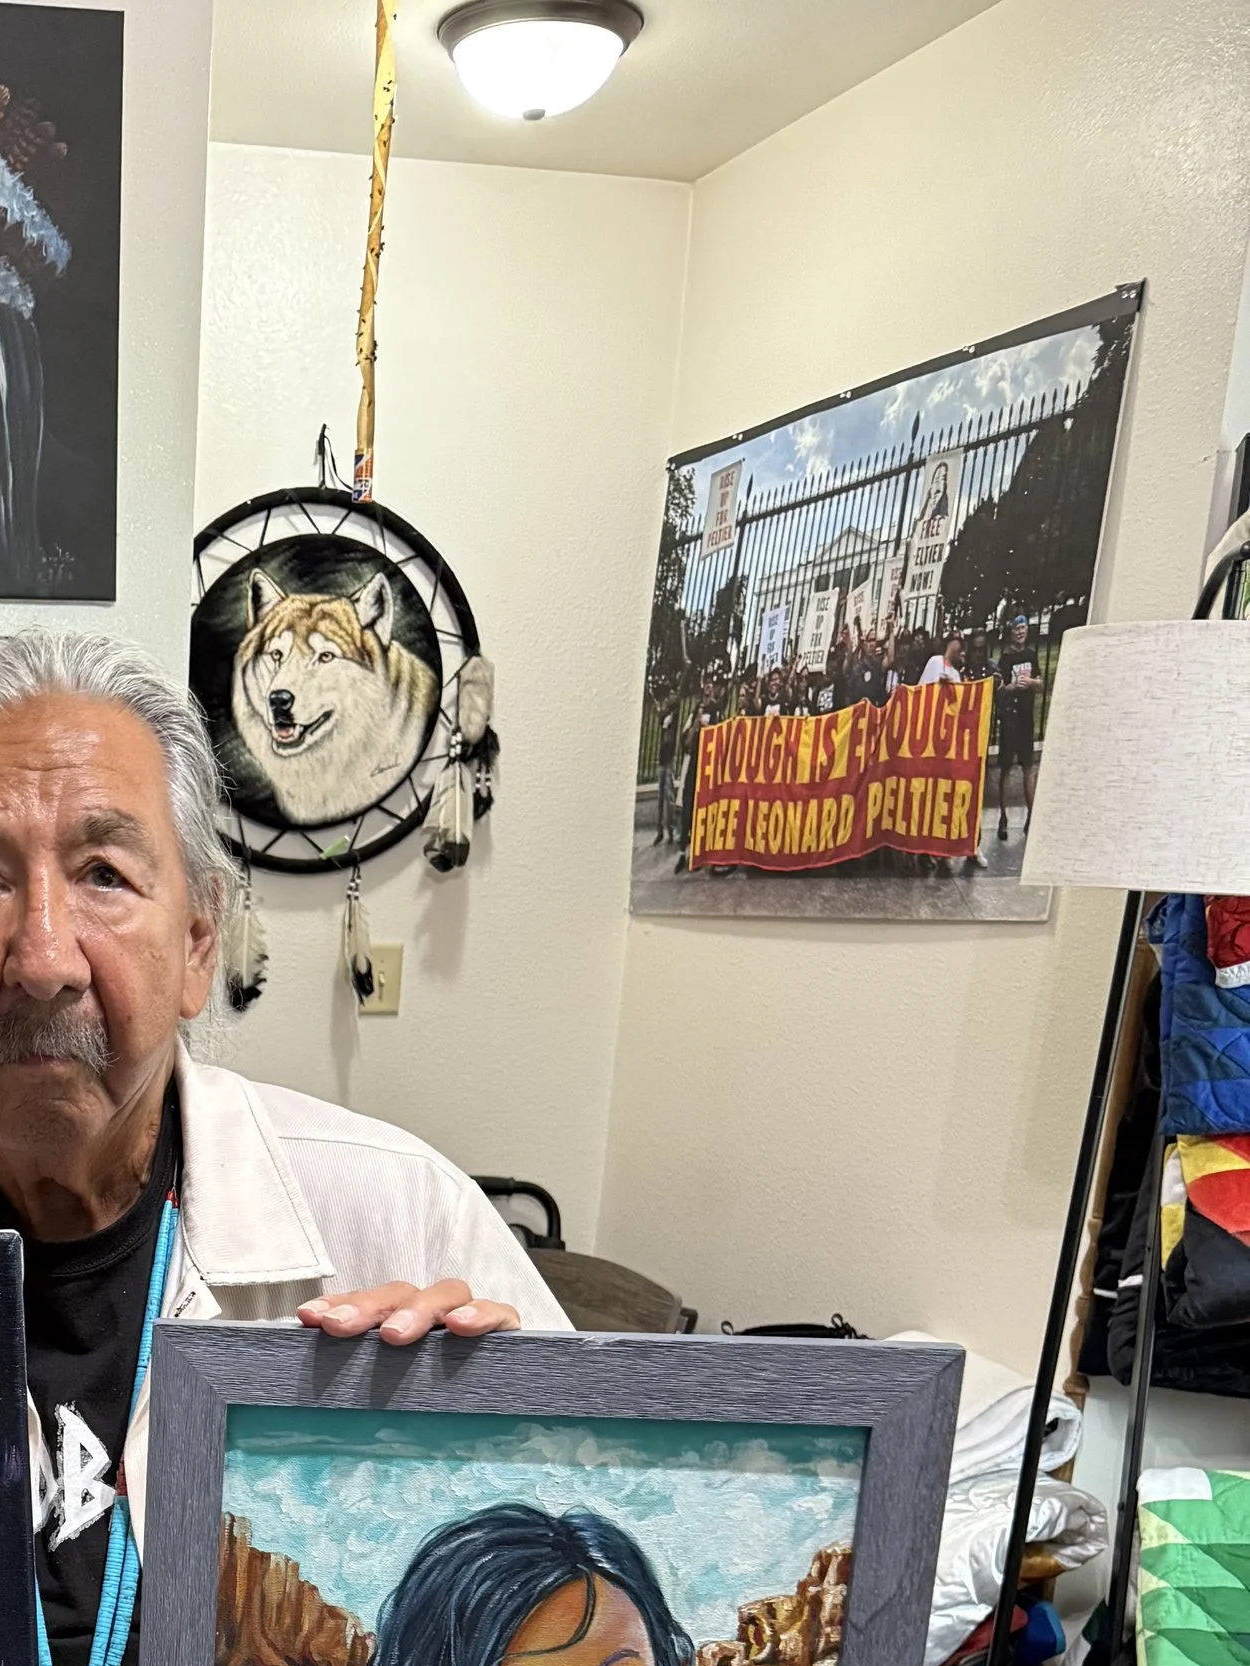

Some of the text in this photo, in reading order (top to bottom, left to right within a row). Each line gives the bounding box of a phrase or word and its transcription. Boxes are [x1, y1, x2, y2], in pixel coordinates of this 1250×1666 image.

[915, 543, 944, 566] ELTIER
[920, 519, 941, 540] FREE
[700, 683, 984, 790] ENOUGH IS ENOUGH
[694, 776, 973, 856] FREE LEONARD PELTIER
